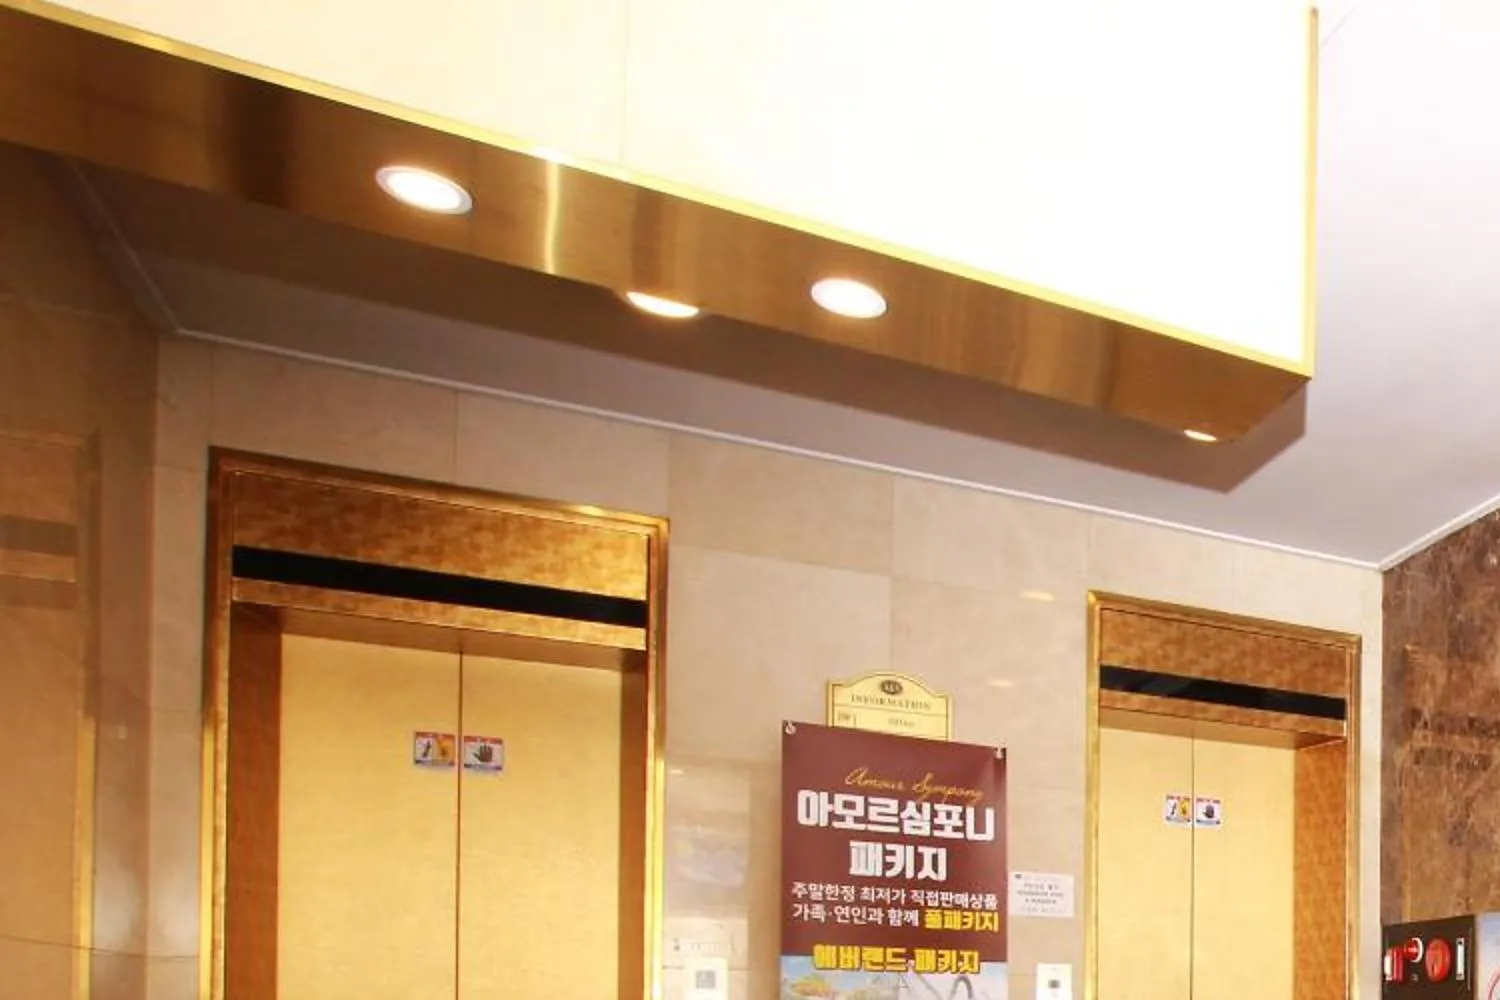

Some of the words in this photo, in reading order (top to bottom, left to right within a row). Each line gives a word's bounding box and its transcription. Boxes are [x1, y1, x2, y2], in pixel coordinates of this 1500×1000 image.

[797, 789, 995, 841] 아모르심포니
[848, 840, 948, 881] 패키지
[791, 881, 855, 903] 주말한정
[861, 885, 906, 906] 최저가
[887, 907, 920, 927] 함께
[812, 944, 908, 973] 에버랜드
[914, 947, 980, 974] 패키지
